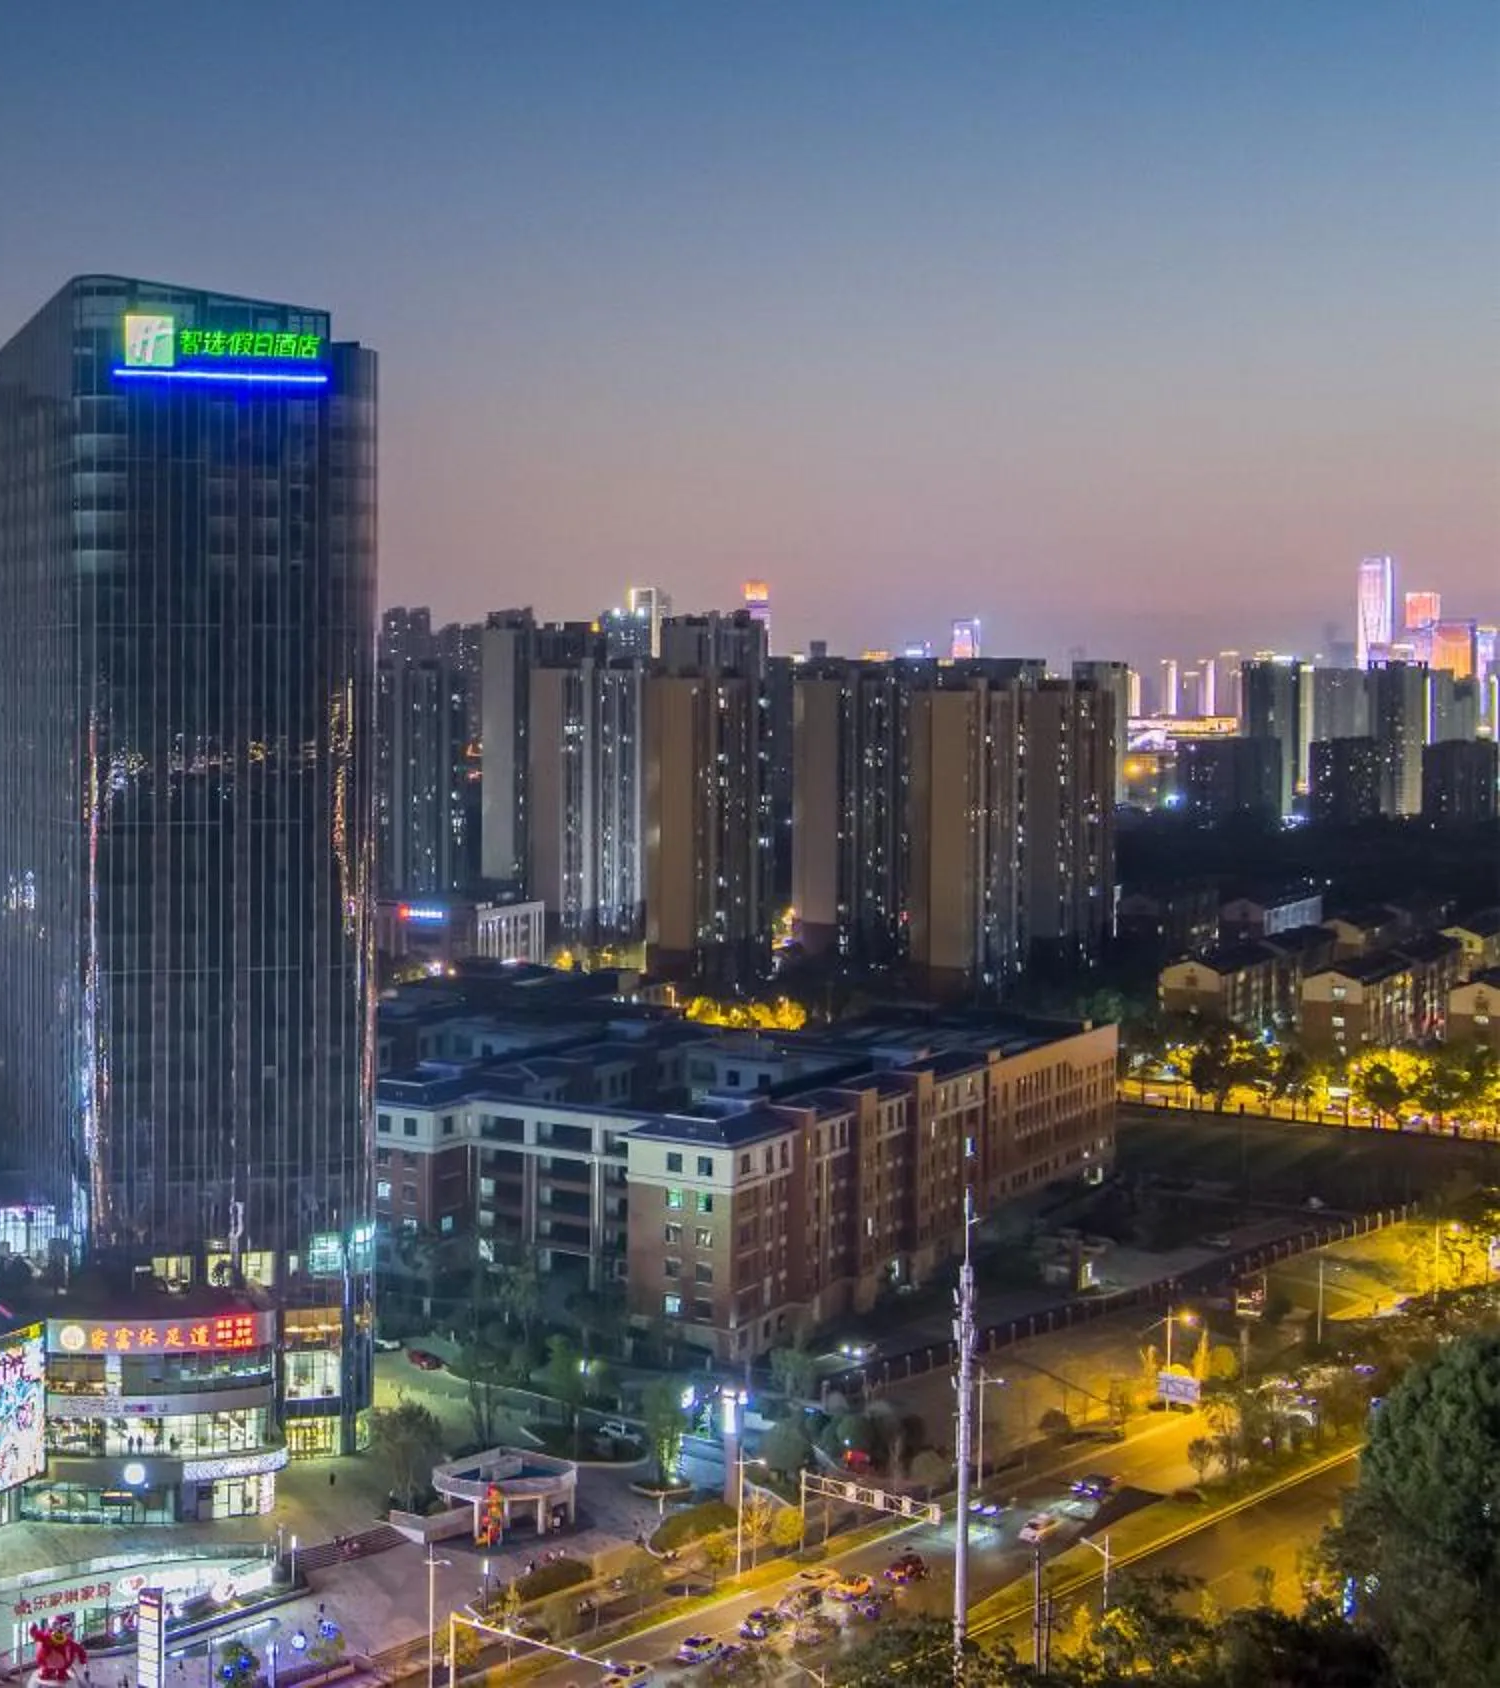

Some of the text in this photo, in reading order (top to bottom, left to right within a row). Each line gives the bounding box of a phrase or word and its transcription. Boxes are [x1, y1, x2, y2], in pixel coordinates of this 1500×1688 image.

[180, 330, 320, 359] 智选假日酒店
